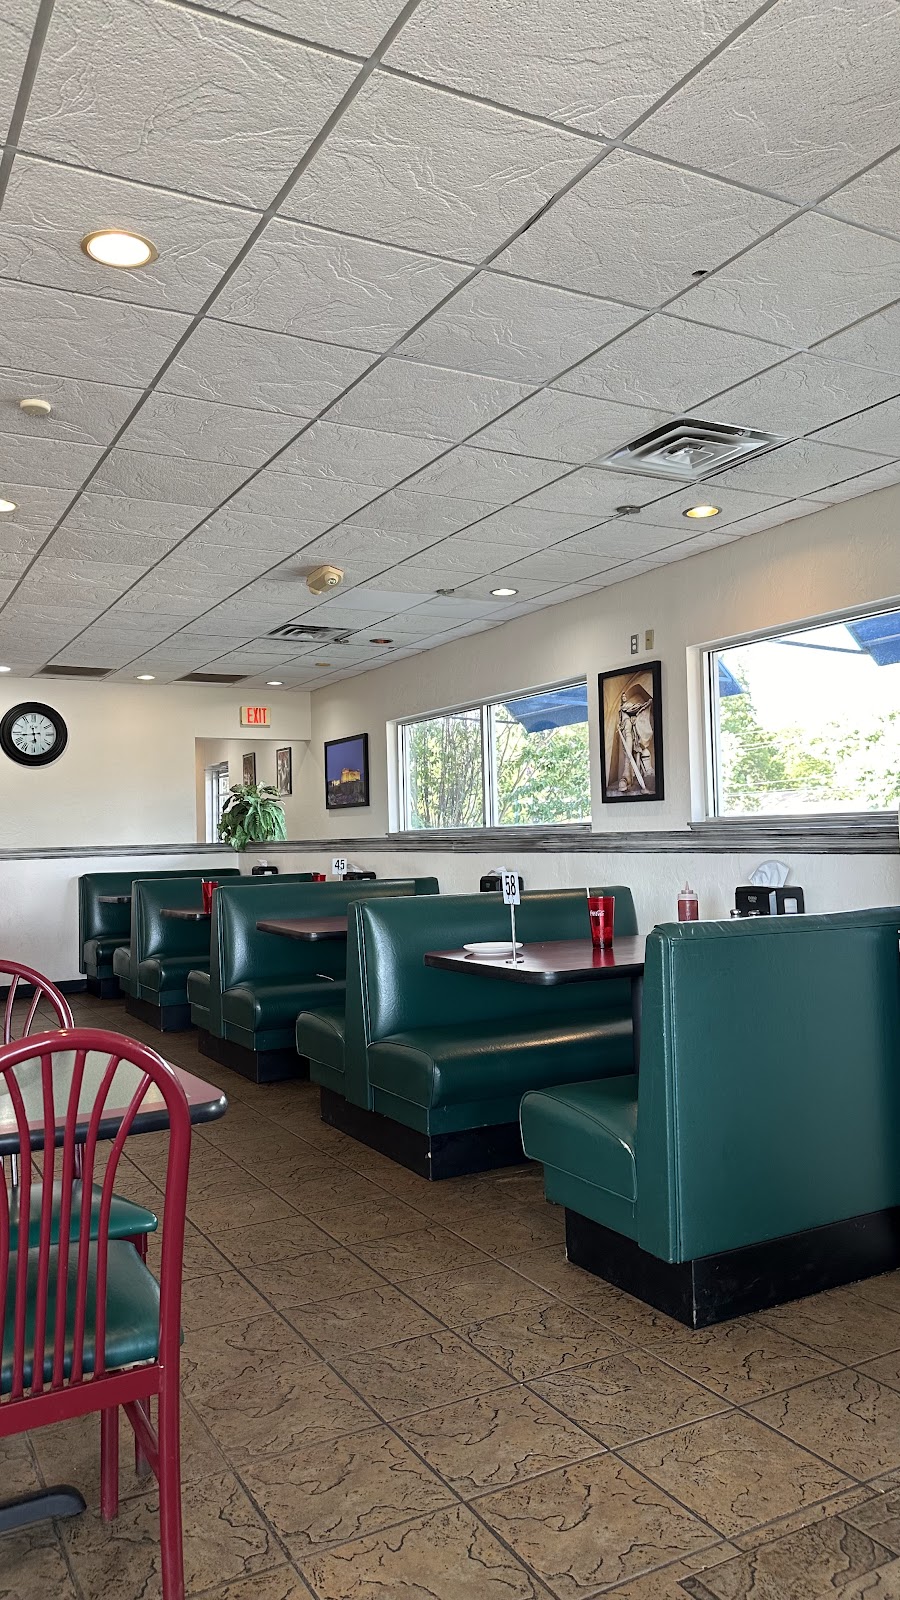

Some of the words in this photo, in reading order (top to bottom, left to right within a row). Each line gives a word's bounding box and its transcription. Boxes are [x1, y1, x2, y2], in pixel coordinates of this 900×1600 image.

[247, 707, 267, 724] EXIT
[334, 859, 345, 870] 45
[505, 875, 516, 896] 58
